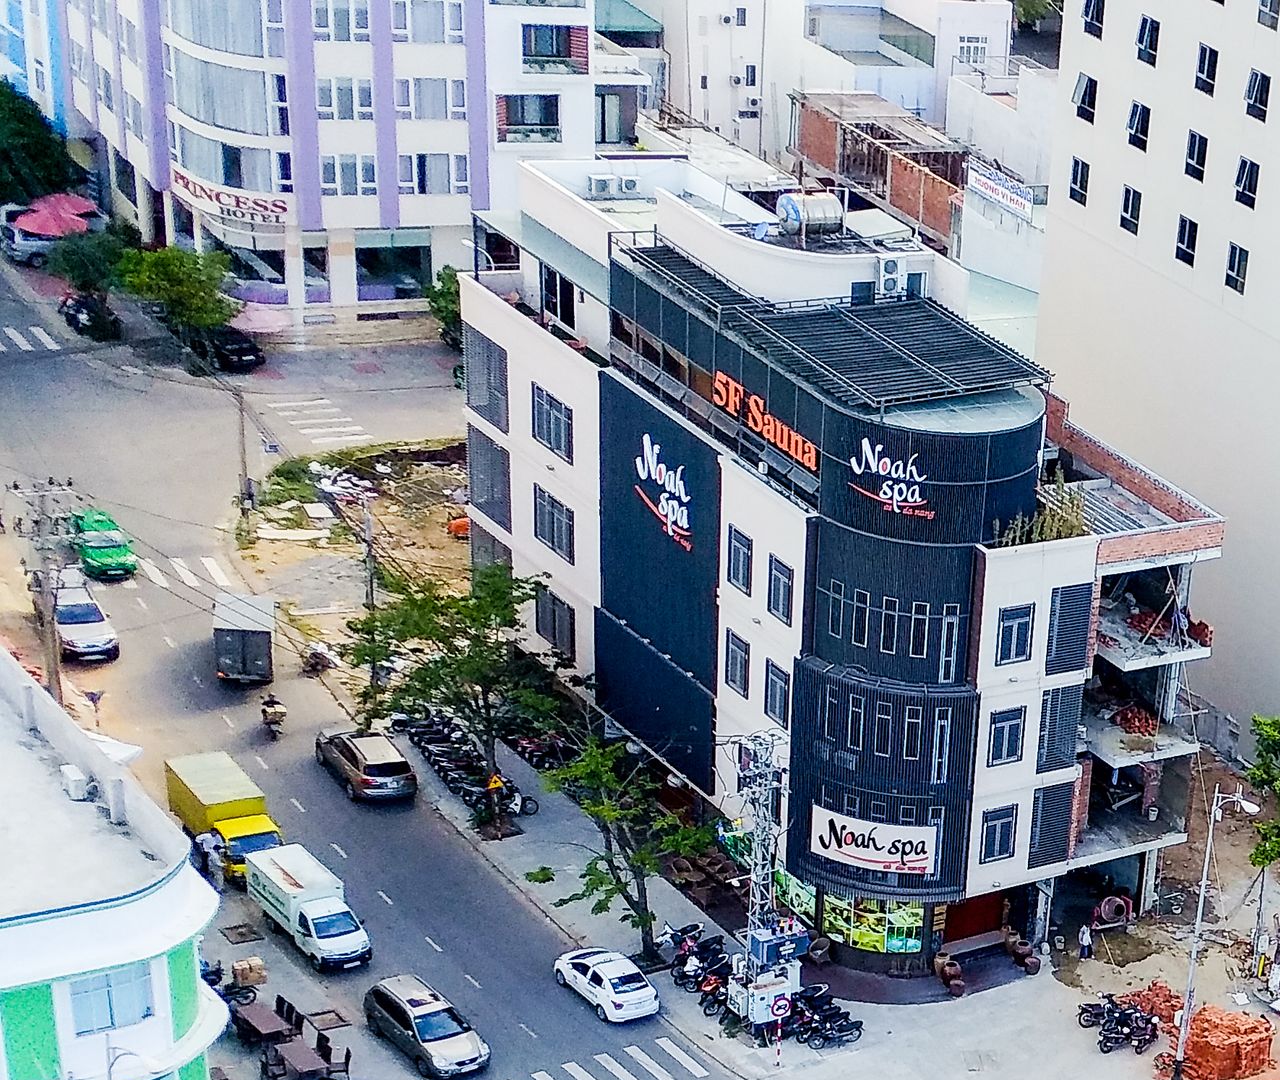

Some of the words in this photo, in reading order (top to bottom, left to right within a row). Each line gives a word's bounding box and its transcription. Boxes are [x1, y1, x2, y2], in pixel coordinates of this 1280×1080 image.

[173, 168, 288, 213] PRINCESS
[219, 206, 286, 224] HOTEL
[713, 370, 744, 417] 5F
[747, 394, 818, 471] Sauna
[635, 433, 692, 503] Noah
[849, 437, 928, 483] Noah
[658, 493, 690, 536] spa
[879, 480, 923, 514] spa
[818, 817, 885, 851] Noah
[887, 838, 928, 866] spa
